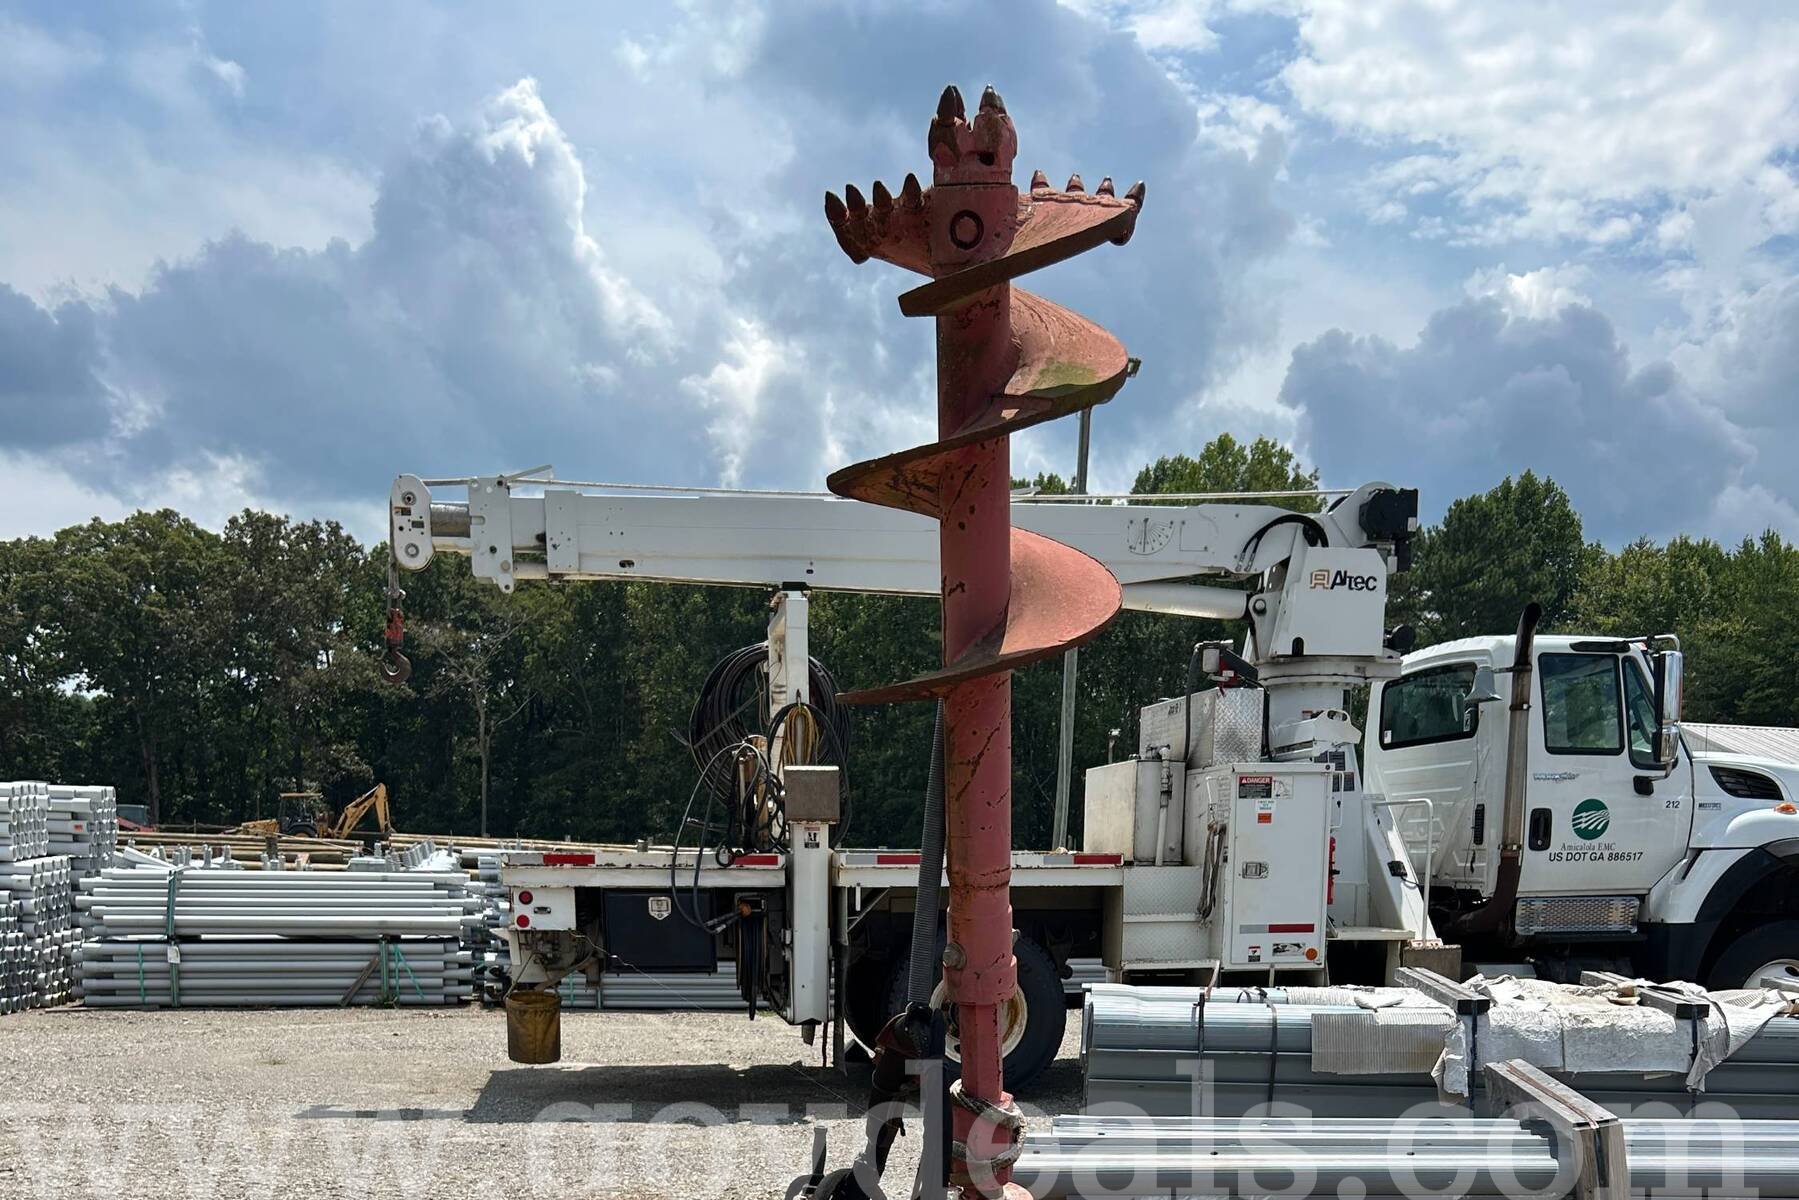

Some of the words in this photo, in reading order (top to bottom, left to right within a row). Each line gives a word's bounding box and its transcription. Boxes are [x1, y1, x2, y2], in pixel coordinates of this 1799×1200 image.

[1330, 570, 1377, 591] Altec
[1665, 800, 1680, 808] 212
[1561, 843, 1595, 851] Amicalola
[1597, 843, 1616, 851] EMC
[1549, 852, 1563, 861] US
[1566, 852, 1588, 861] DOT
[1589, 852, 1604, 861] GA
[1607, 852, 1643, 861] 886517
